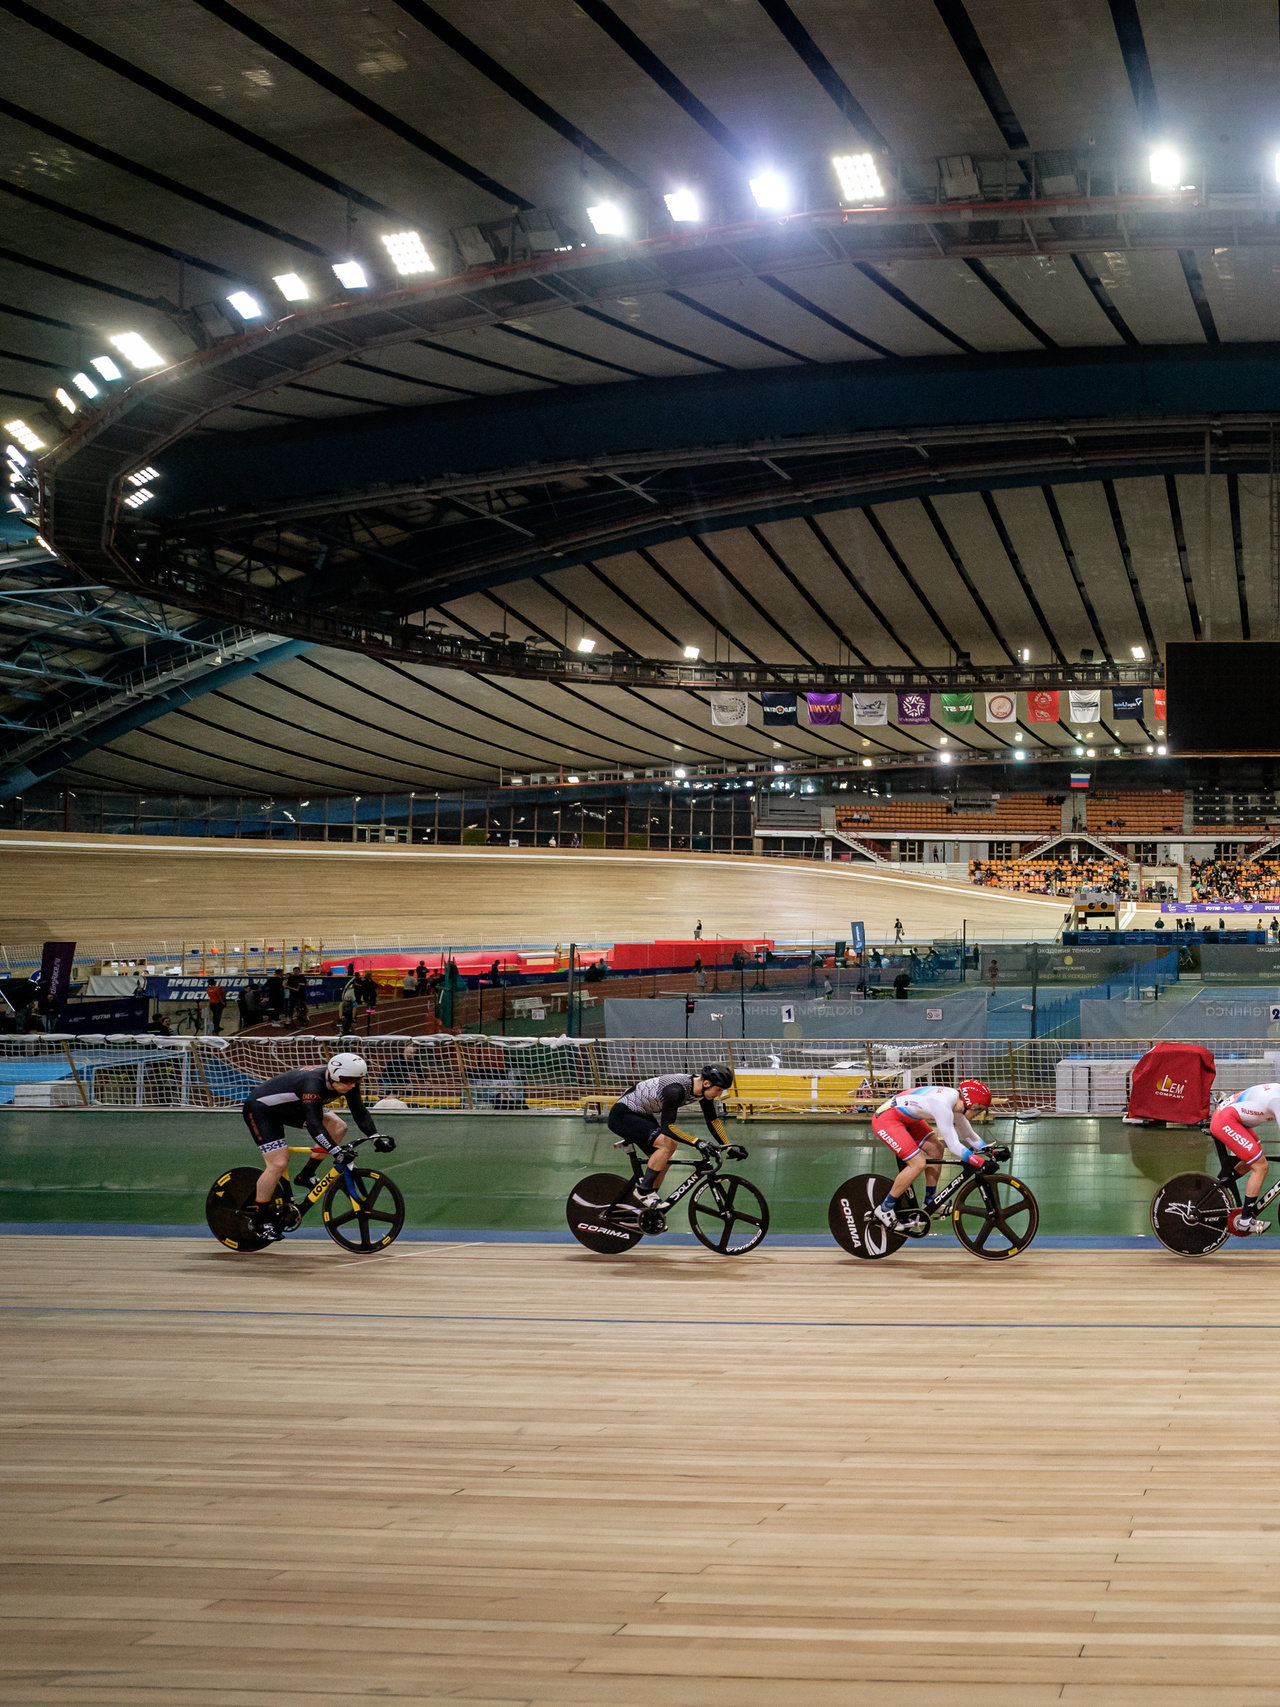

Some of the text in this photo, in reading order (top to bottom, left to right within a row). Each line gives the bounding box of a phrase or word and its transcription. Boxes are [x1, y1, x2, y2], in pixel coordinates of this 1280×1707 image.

[785, 1008, 792, 1019] 1
[1271, 1008, 1280, 1019] 2
[1155, 1090, 1185, 1099] COMPANY
[1161, 1074, 1185, 1095] LEM
[1240, 1107, 1265, 1116] RUSSIA
[877, 1129, 902, 1154] RUSSIA
[1221, 1124, 1254, 1152] RUSSIA
[312, 1173, 335, 1197] LOOK
[669, 1173, 699, 1201] DOLAN
[933, 1174, 965, 1205] DOLAN
[577, 1222, 630, 1240] CORIMA
[840, 1198, 862, 1248] CORIMA
